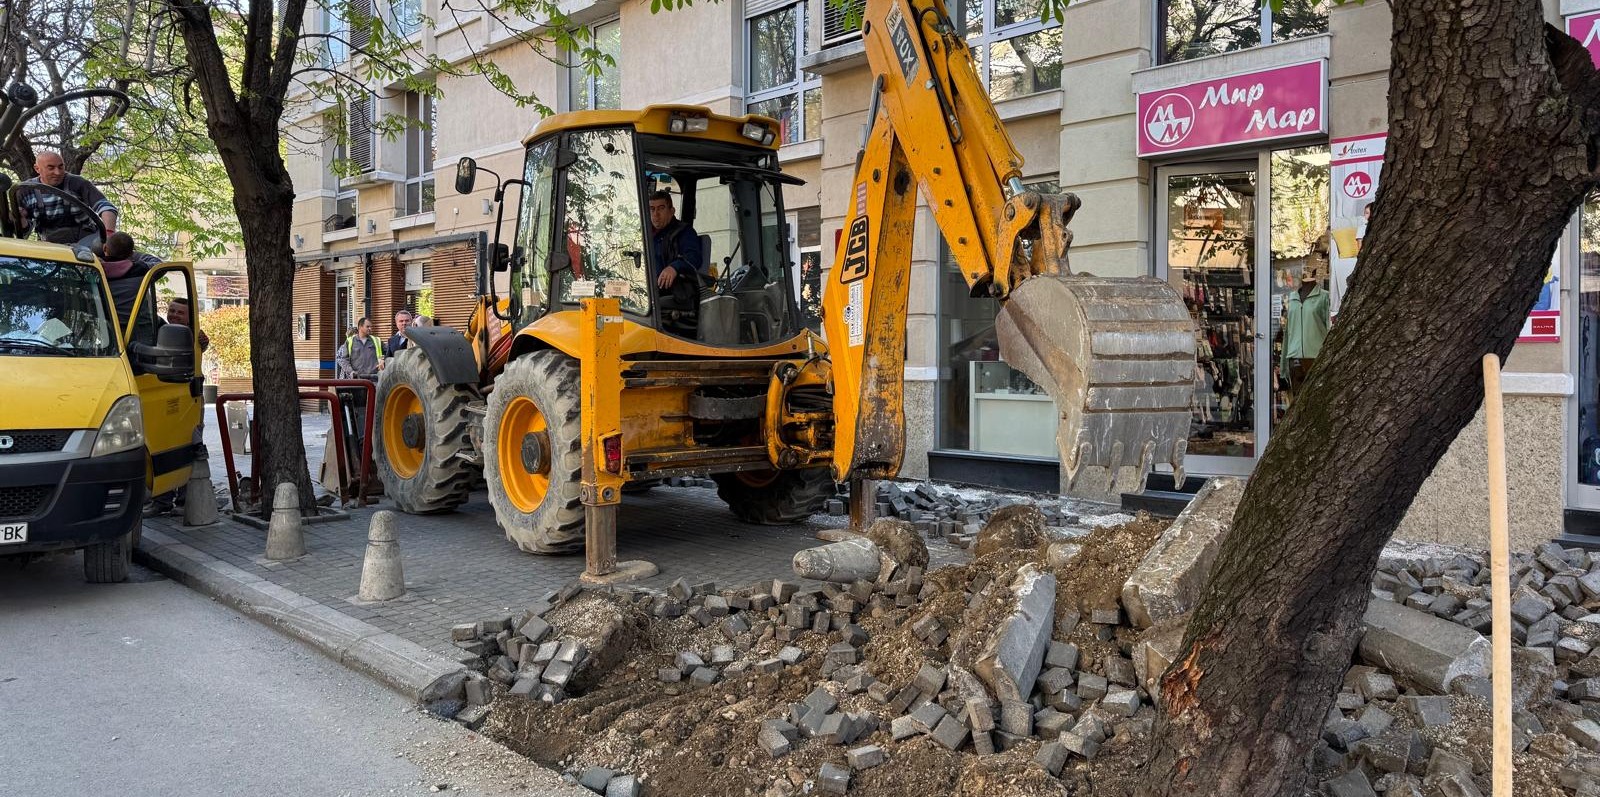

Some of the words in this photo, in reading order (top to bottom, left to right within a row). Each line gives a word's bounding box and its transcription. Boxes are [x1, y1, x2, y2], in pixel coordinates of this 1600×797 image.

[895, 26, 915, 69] AUX
[1199, 82, 1264, 109] Мир
[1244, 107, 1315, 133] Мар
[844, 220, 866, 275] JCB
